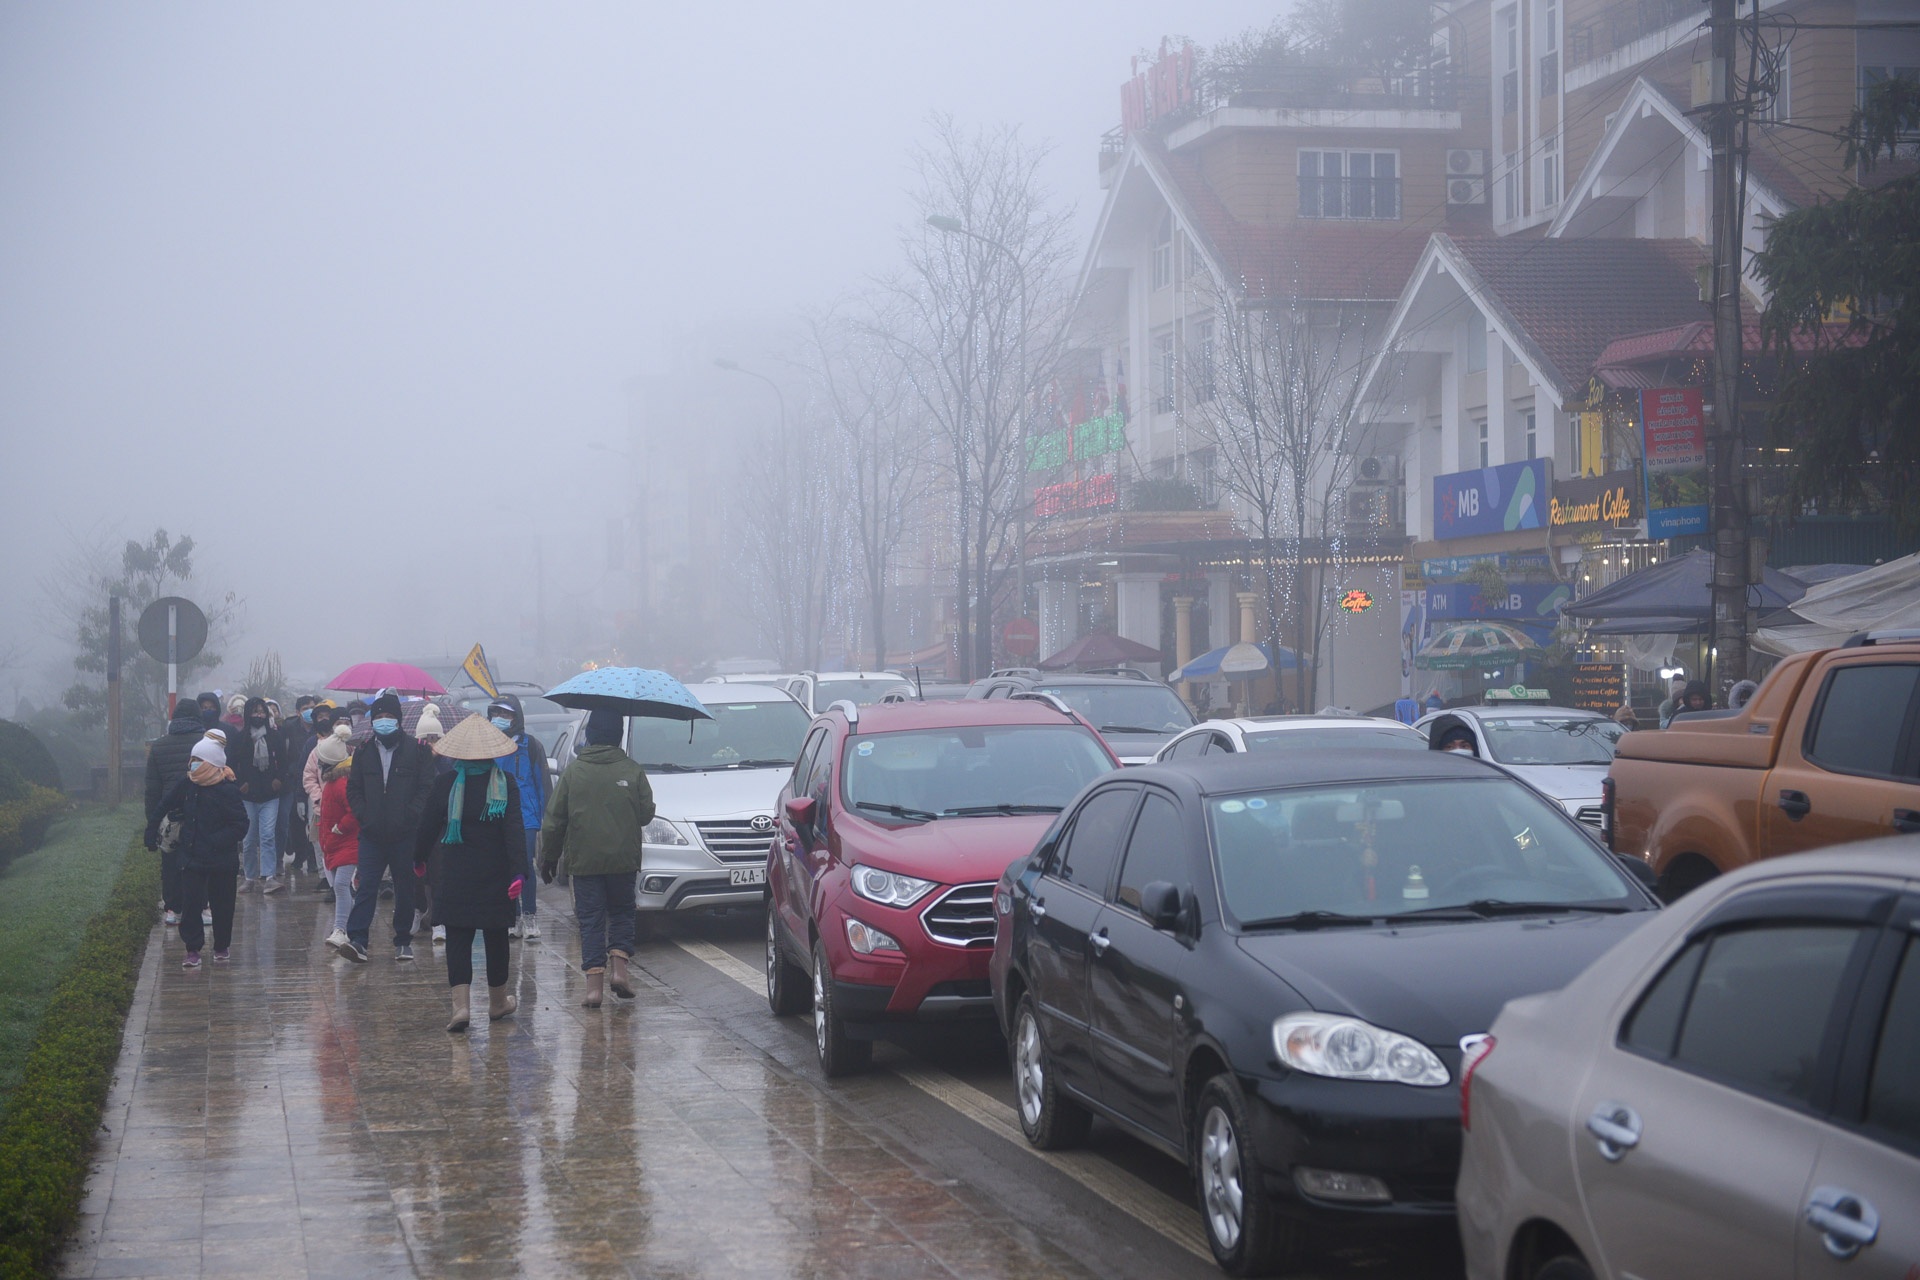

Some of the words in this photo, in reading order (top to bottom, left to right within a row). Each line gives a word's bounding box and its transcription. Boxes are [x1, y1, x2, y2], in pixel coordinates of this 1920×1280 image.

[1589, 376, 1604, 407] Bar
[1458, 488, 1479, 518] MB
[1550, 495, 1600, 526] Restaurant
[1602, 486, 1630, 529] Coffee
[1660, 516, 1701, 527] vinaphone
[1341, 597, 1372, 609] Coffee
[1432, 594, 1447, 610] ATM
[1493, 594, 1522, 610] MB
[1598, 664, 1613, 672] food
[1603, 676, 1620, 684] Coffee
[1600, 688, 1619, 696] Coffee
